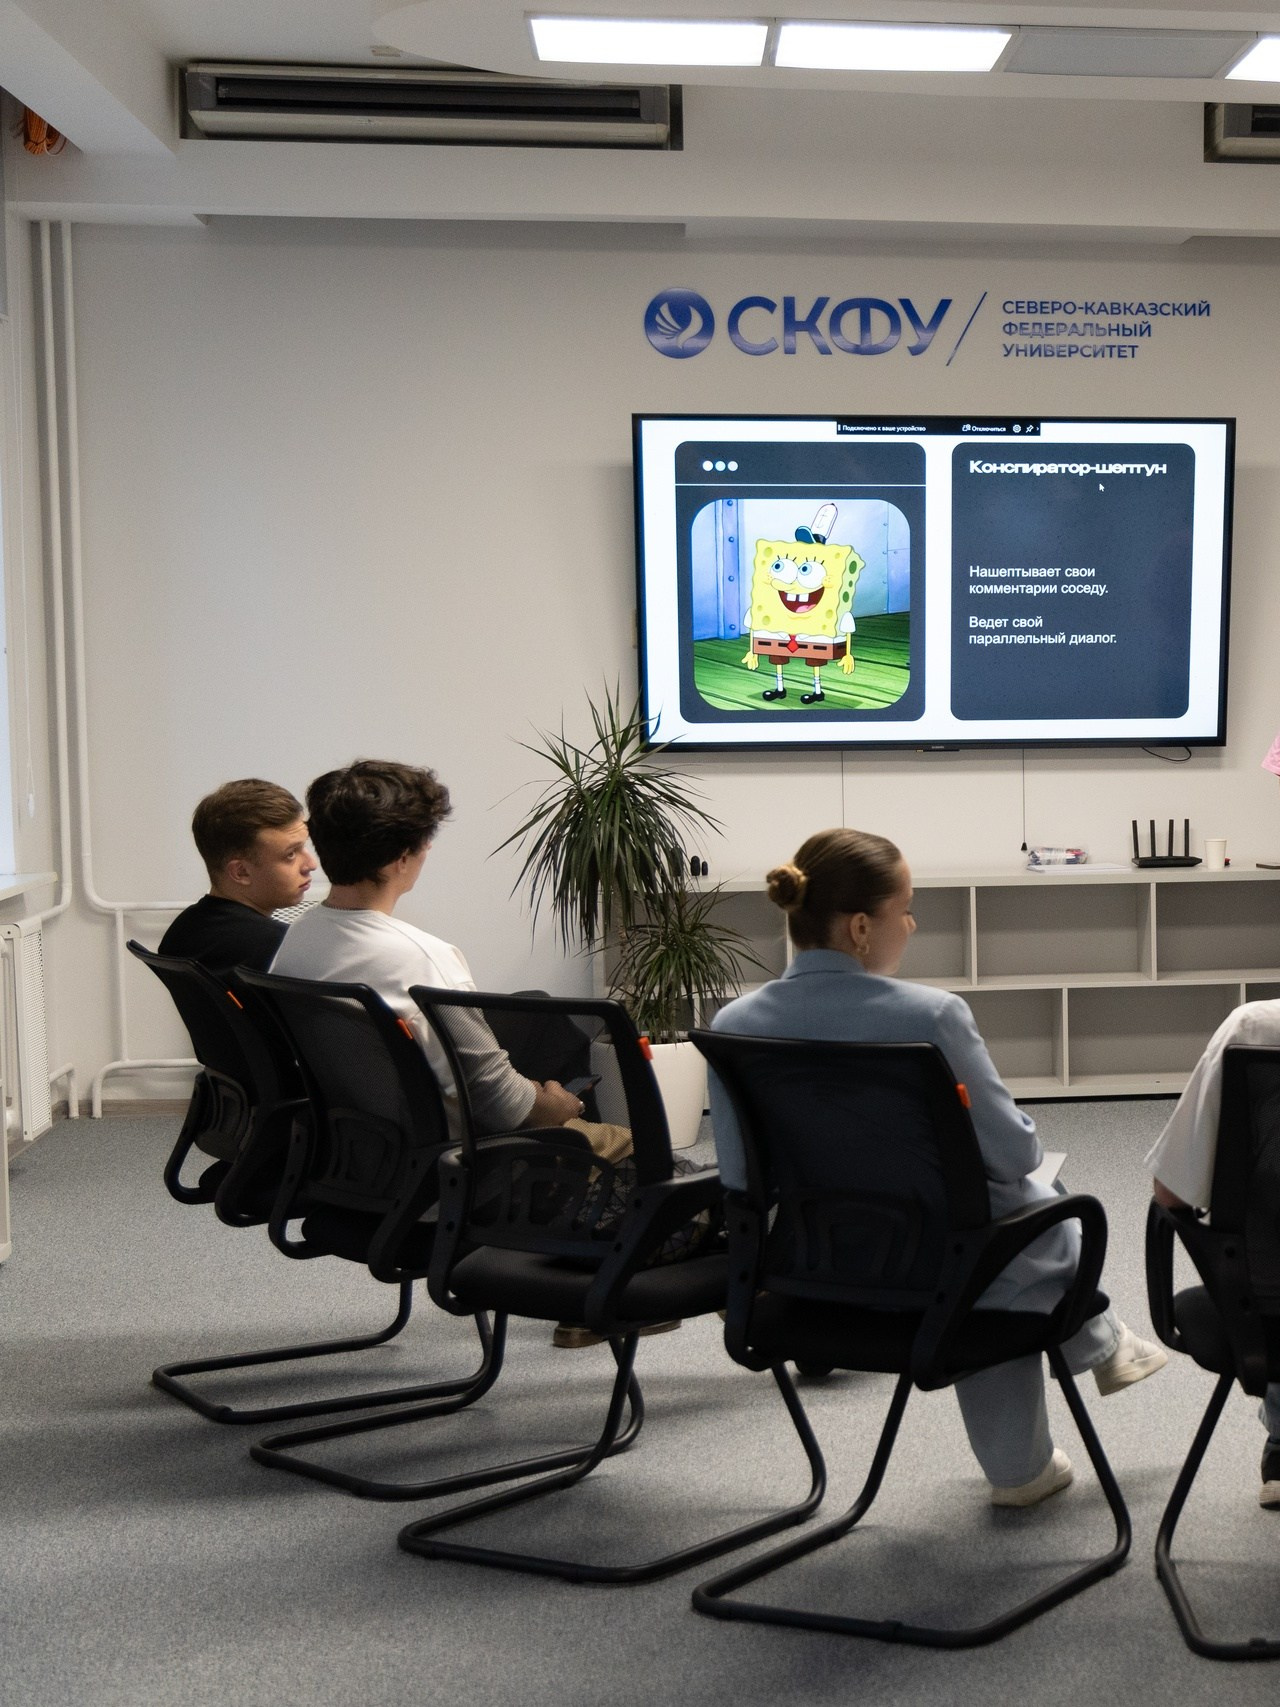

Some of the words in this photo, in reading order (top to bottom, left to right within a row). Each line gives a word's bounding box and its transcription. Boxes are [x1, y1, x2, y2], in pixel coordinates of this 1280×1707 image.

[1003, 300, 1212, 318] СЕВЕРО-КАВКАЗСКИЙ
[727, 295, 952, 357] СКФУ
[1003, 321, 1153, 338] ФЕДЕРАЛЬНЫЙ
[1003, 343, 1139, 360] УНИВЕРСИТЕТ
[897, 425, 926, 433] устройство
[969, 460, 1167, 476] Конспиратор-шептун
[969, 565, 1062, 578] Нашептывает
[1064, 567, 1096, 578] свои
[969, 584, 1058, 596] комментарии
[1060, 584, 1109, 596] соседу.
[969, 616, 1009, 628] Ведет
[1012, 615, 1043, 628] свой
[968, 632, 1066, 646] параллельный
[1068, 632, 1117, 646] диалог.
